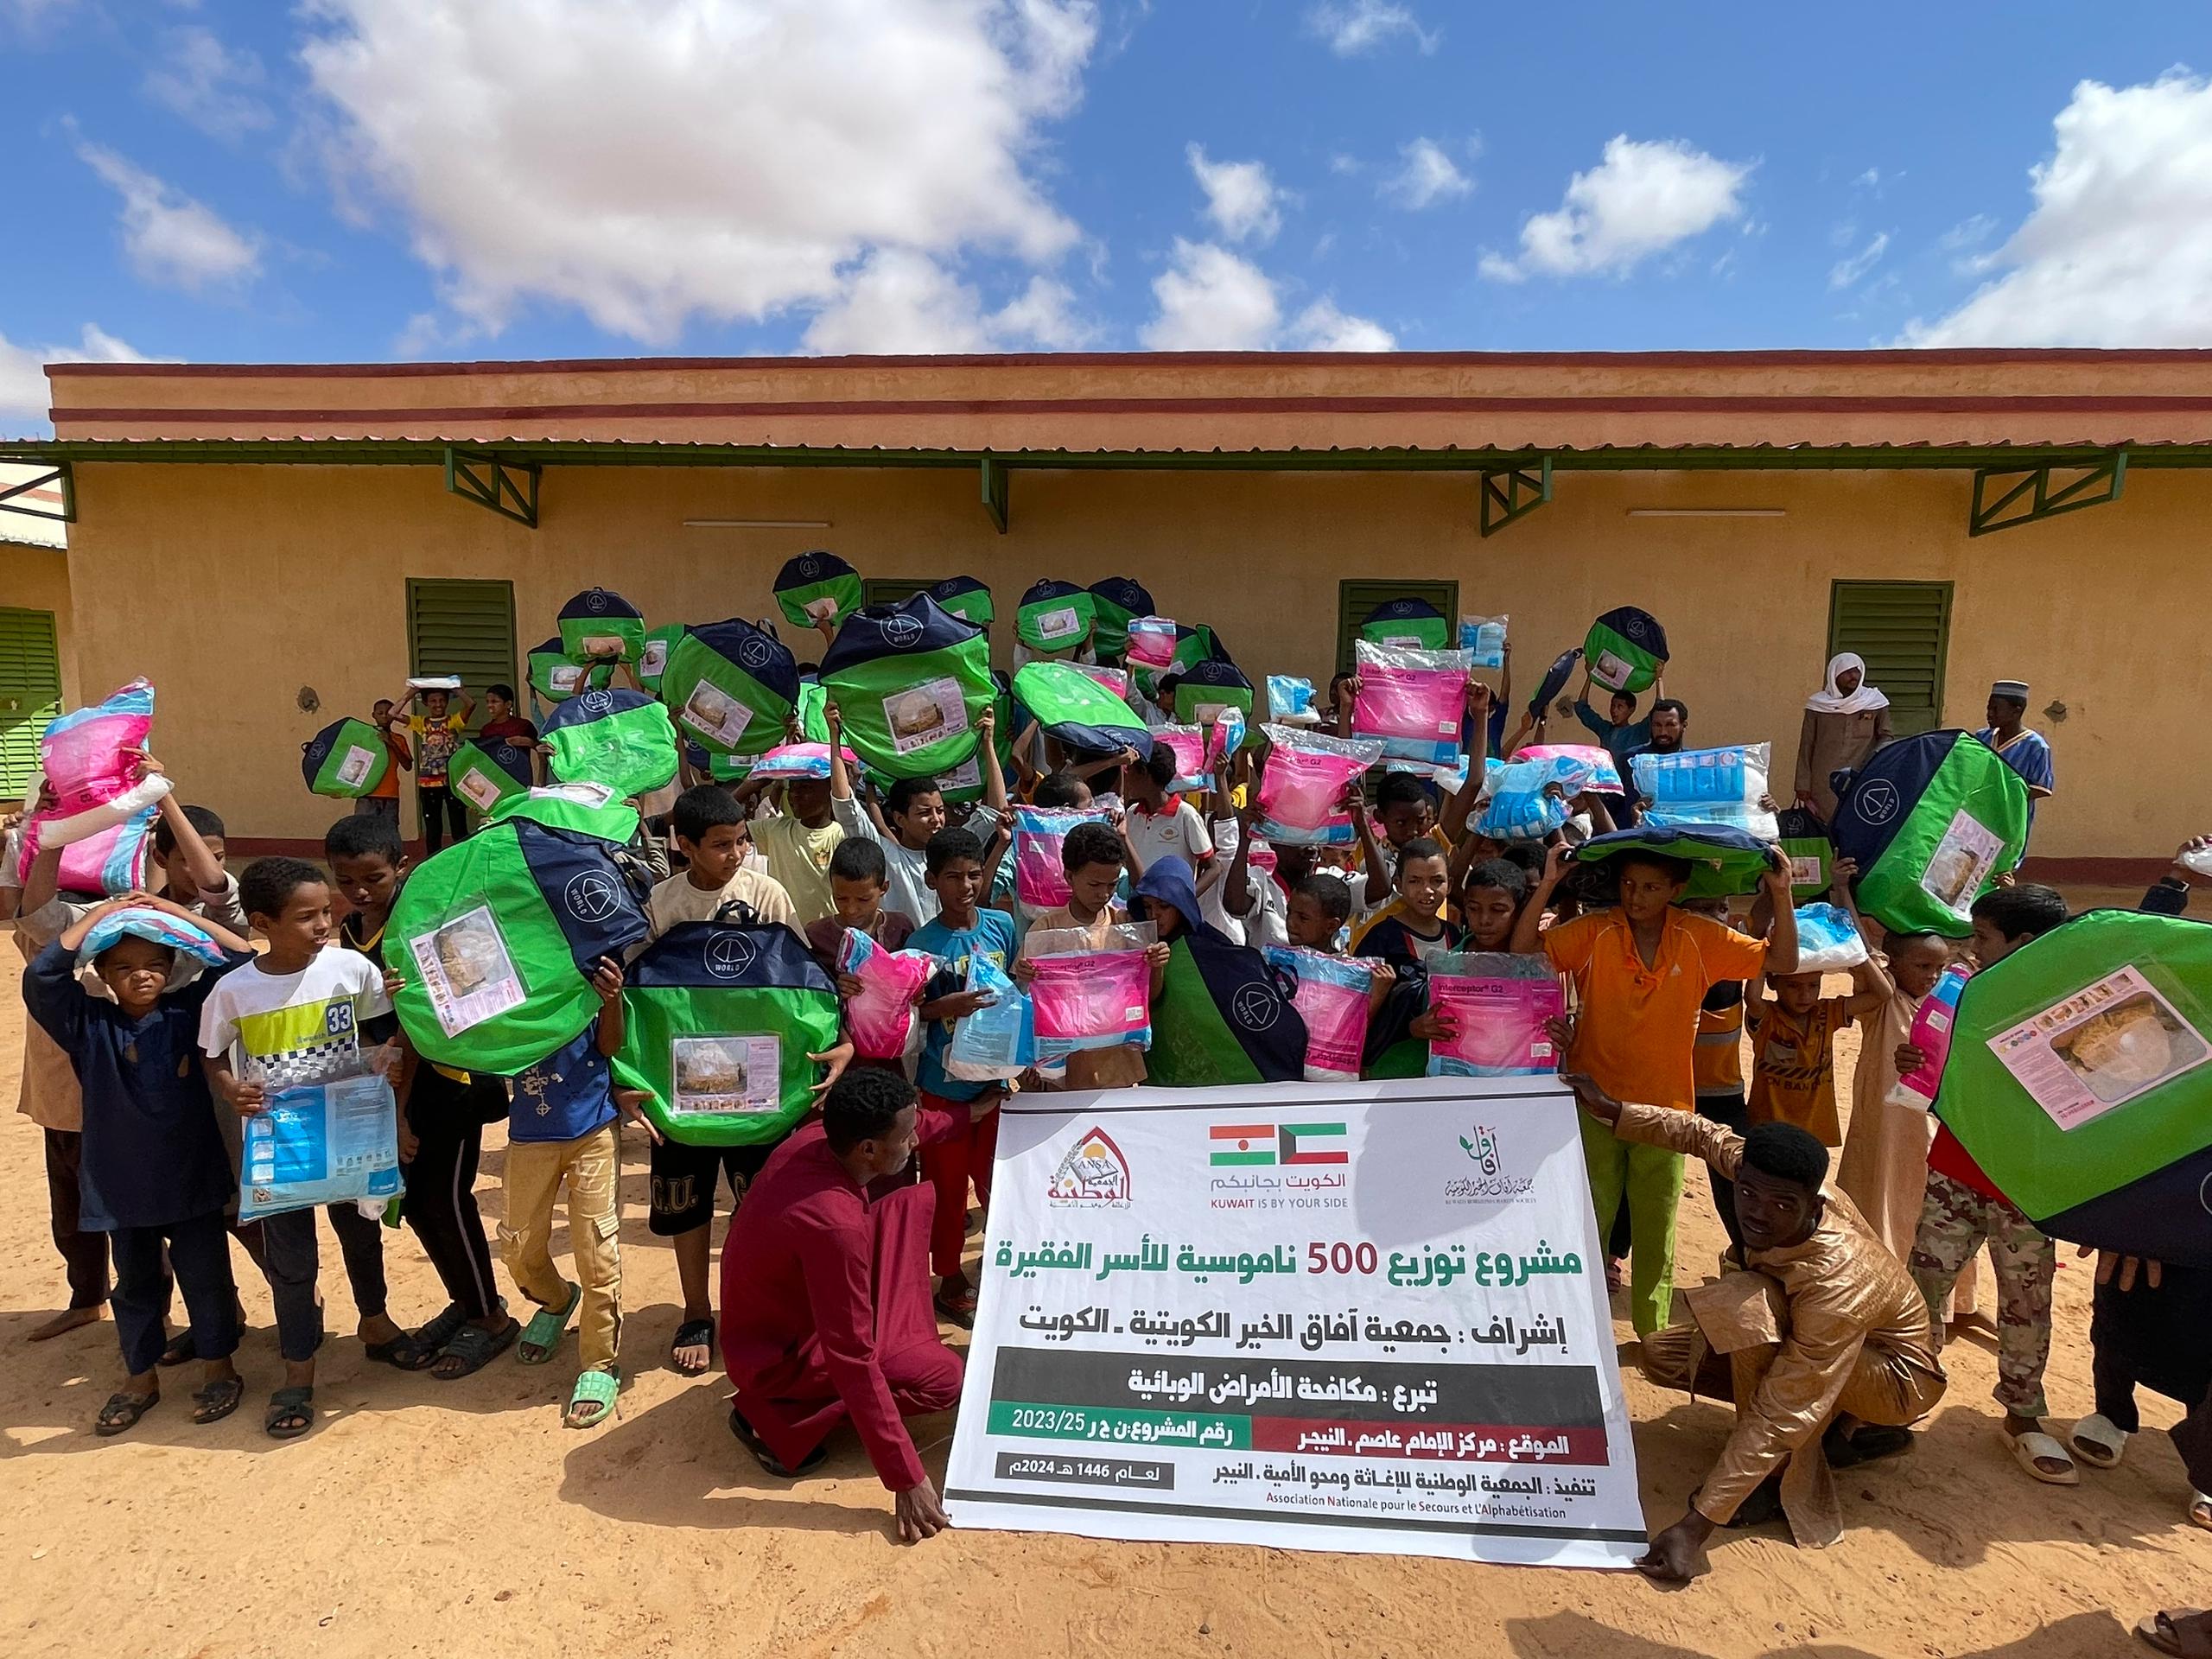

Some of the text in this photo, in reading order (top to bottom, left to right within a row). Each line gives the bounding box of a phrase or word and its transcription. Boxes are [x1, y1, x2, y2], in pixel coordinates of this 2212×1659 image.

[570, 888, 587, 914] WORLD
[328, 1005, 352, 1033] 33
[1078, 1160, 1110, 1169] ANSA
[1211, 1173, 1345, 1192] الكويت بجانبكم
[1211, 1198, 1348, 1208] KUWAIT IS BY YOUR SIDE
[995, 1233, 1582, 1287] مشروع توزيع 500 ناموسية للأسر الفقيرة
[1019, 1305, 1109, 1341] الكويت
[1129, 1309, 1230, 1347] الكويتية
[1236, 1313, 1293, 1350] الخير
[1300, 1308, 1358, 1351] آفاق
[1364, 1314, 1452, 1354] جمعية
[1471, 1313, 1568, 1355] إشراف
[1128, 1369, 1205, 1402] الوبائية
[1209, 1368, 1292, 1406] الأمراض
[1296, 1376, 1377, 1402] مكافحة
[1392, 1380, 1438, 1412] تبرع
[1012, 1408, 1085, 1433] 2023/25
[1198, 1426, 1233, 1446] رقم
[1297, 1427, 1345, 1452] النيجر
[1355, 1430, 1402, 1453] عاصم
[1405, 1430, 1453, 1457] الإمام
[1457, 1431, 1497, 1459] مركز
[1508, 1434, 1570, 1460] الموقع
[1077, 1463, 1110, 1478] 1446
[1213, 1463, 1253, 1484] النيجر
[1263, 1459, 1306, 1488] الأمية
[1310, 1471, 1351, 1491] ومحو
[1415, 1472, 1477, 1497] الوطنية
[1480, 1474, 1542, 1501] الجمعية
[1554, 1477, 1596, 1503] تنفيذ
[1266, 1492, 1325, 1505] Association
[1327, 1498, 1378, 1510] Nationale
[1381, 1502, 1405, 1512] pour
[1407, 1501, 1417, 1510] le
[1419, 1501, 1460, 1514] Secours
[1461, 1503, 1472, 1514] et
